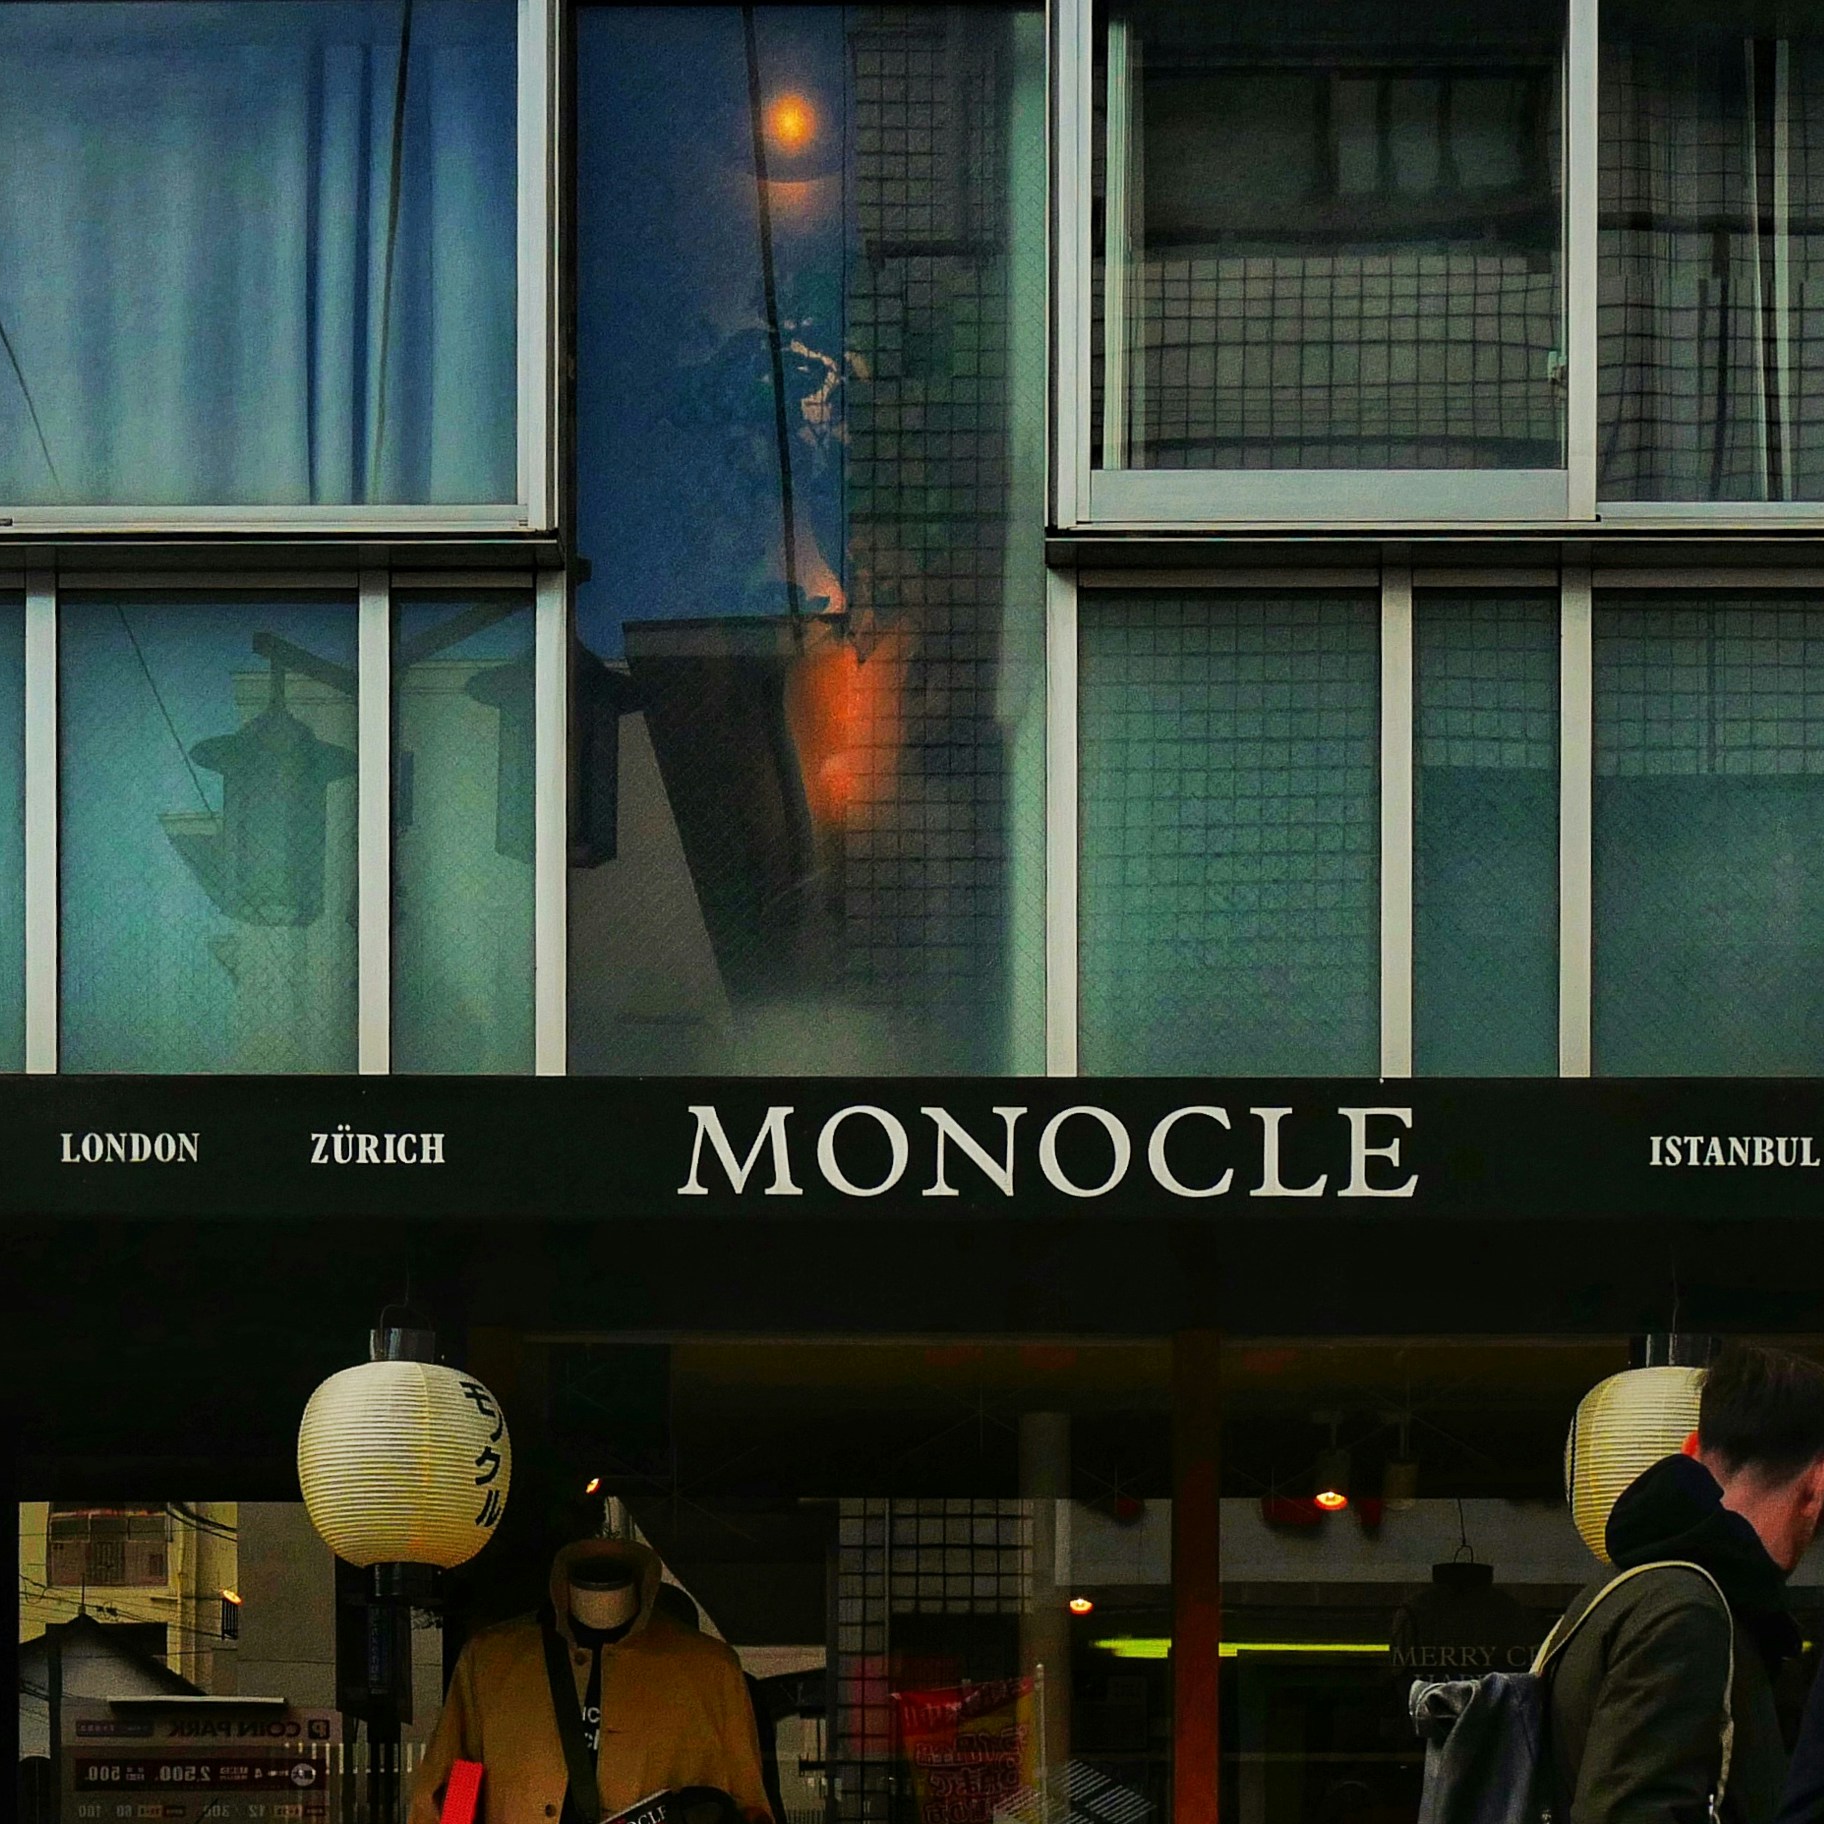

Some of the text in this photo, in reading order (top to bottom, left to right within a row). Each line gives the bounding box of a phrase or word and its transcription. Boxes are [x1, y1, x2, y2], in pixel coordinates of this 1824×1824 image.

[60, 1132, 200, 1163] LONDON
[310, 1124, 446, 1164] ZÜRICH
[677, 1105, 1419, 1198] MONOCLE
[1649, 1135, 1821, 1167] ISTANBUL
[1391, 1645, 1496, 1667] MERRY
